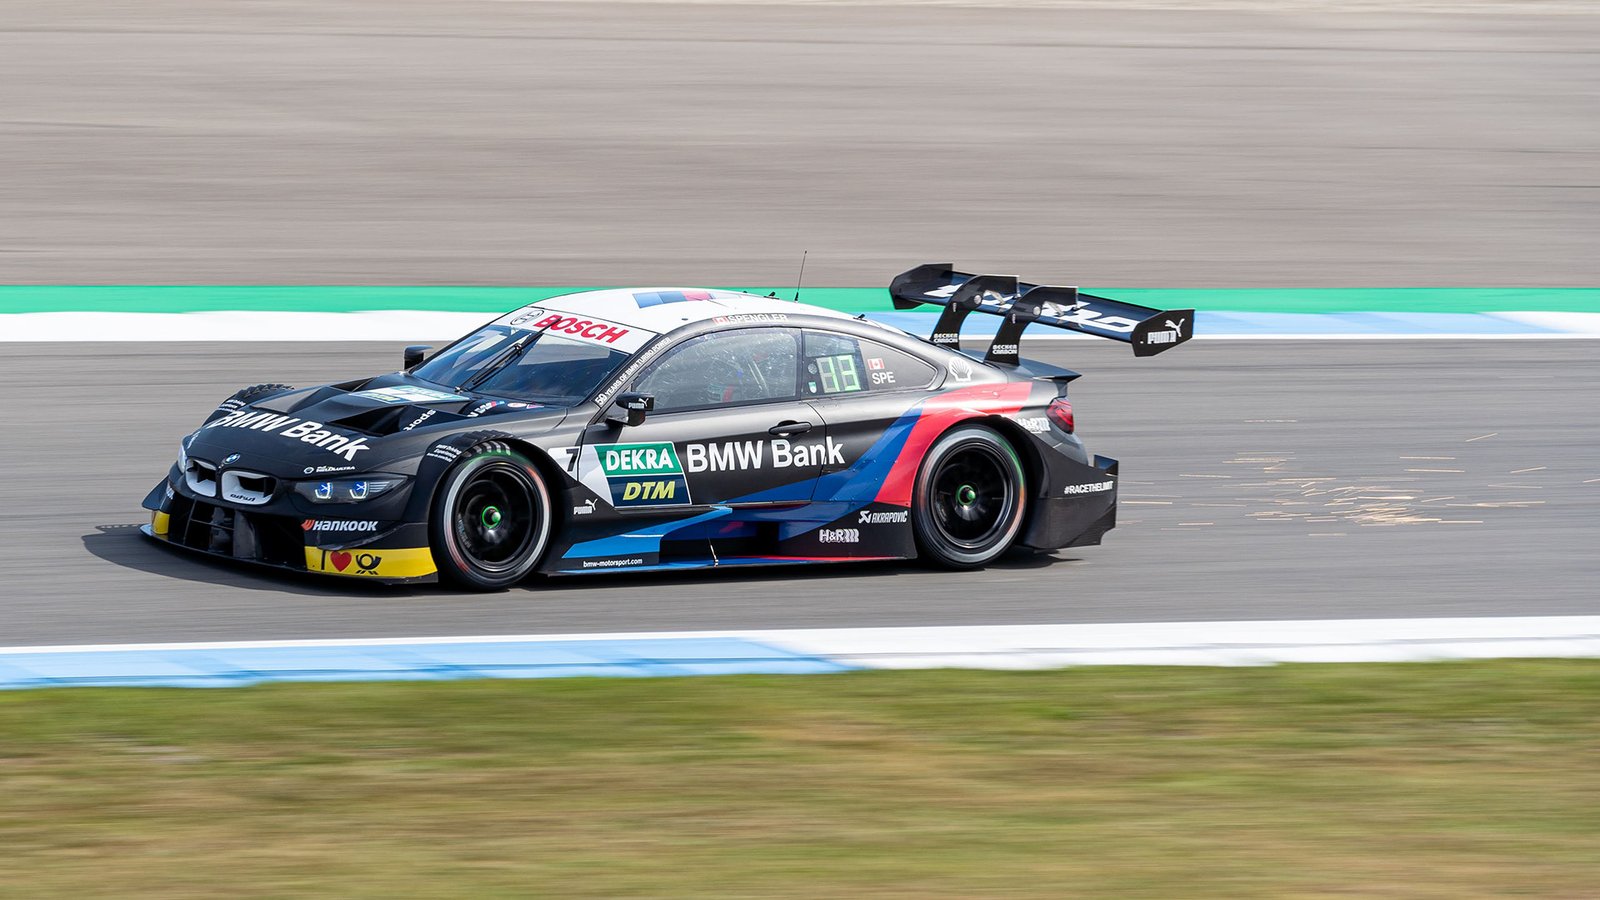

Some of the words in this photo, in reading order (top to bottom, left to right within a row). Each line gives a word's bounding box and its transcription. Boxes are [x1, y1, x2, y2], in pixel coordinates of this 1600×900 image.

[533, 314, 629, 343] BOSCH
[727, 313, 789, 325] SPENGLER
[1147, 330, 1177, 344] PUMA
[605, 380, 622, 396] YEARS
[619, 373, 628, 383] OF
[626, 363, 639, 376] BMW
[637, 349, 653, 365] TURBO
[652, 337, 672, 352] POWER
[871, 371, 896, 384] SPE
[403, 409, 437, 431] sport
[205, 410, 300, 432] BMW
[280, 421, 370, 462] Bank
[606, 448, 673, 471] DEKRA
[686, 440, 764, 473] BMW
[771, 436, 846, 468] Bank
[623, 481, 675, 500] DTM
[320, 550, 327, 571] I
[583, 559, 643, 568] bmw-motorsport.com
